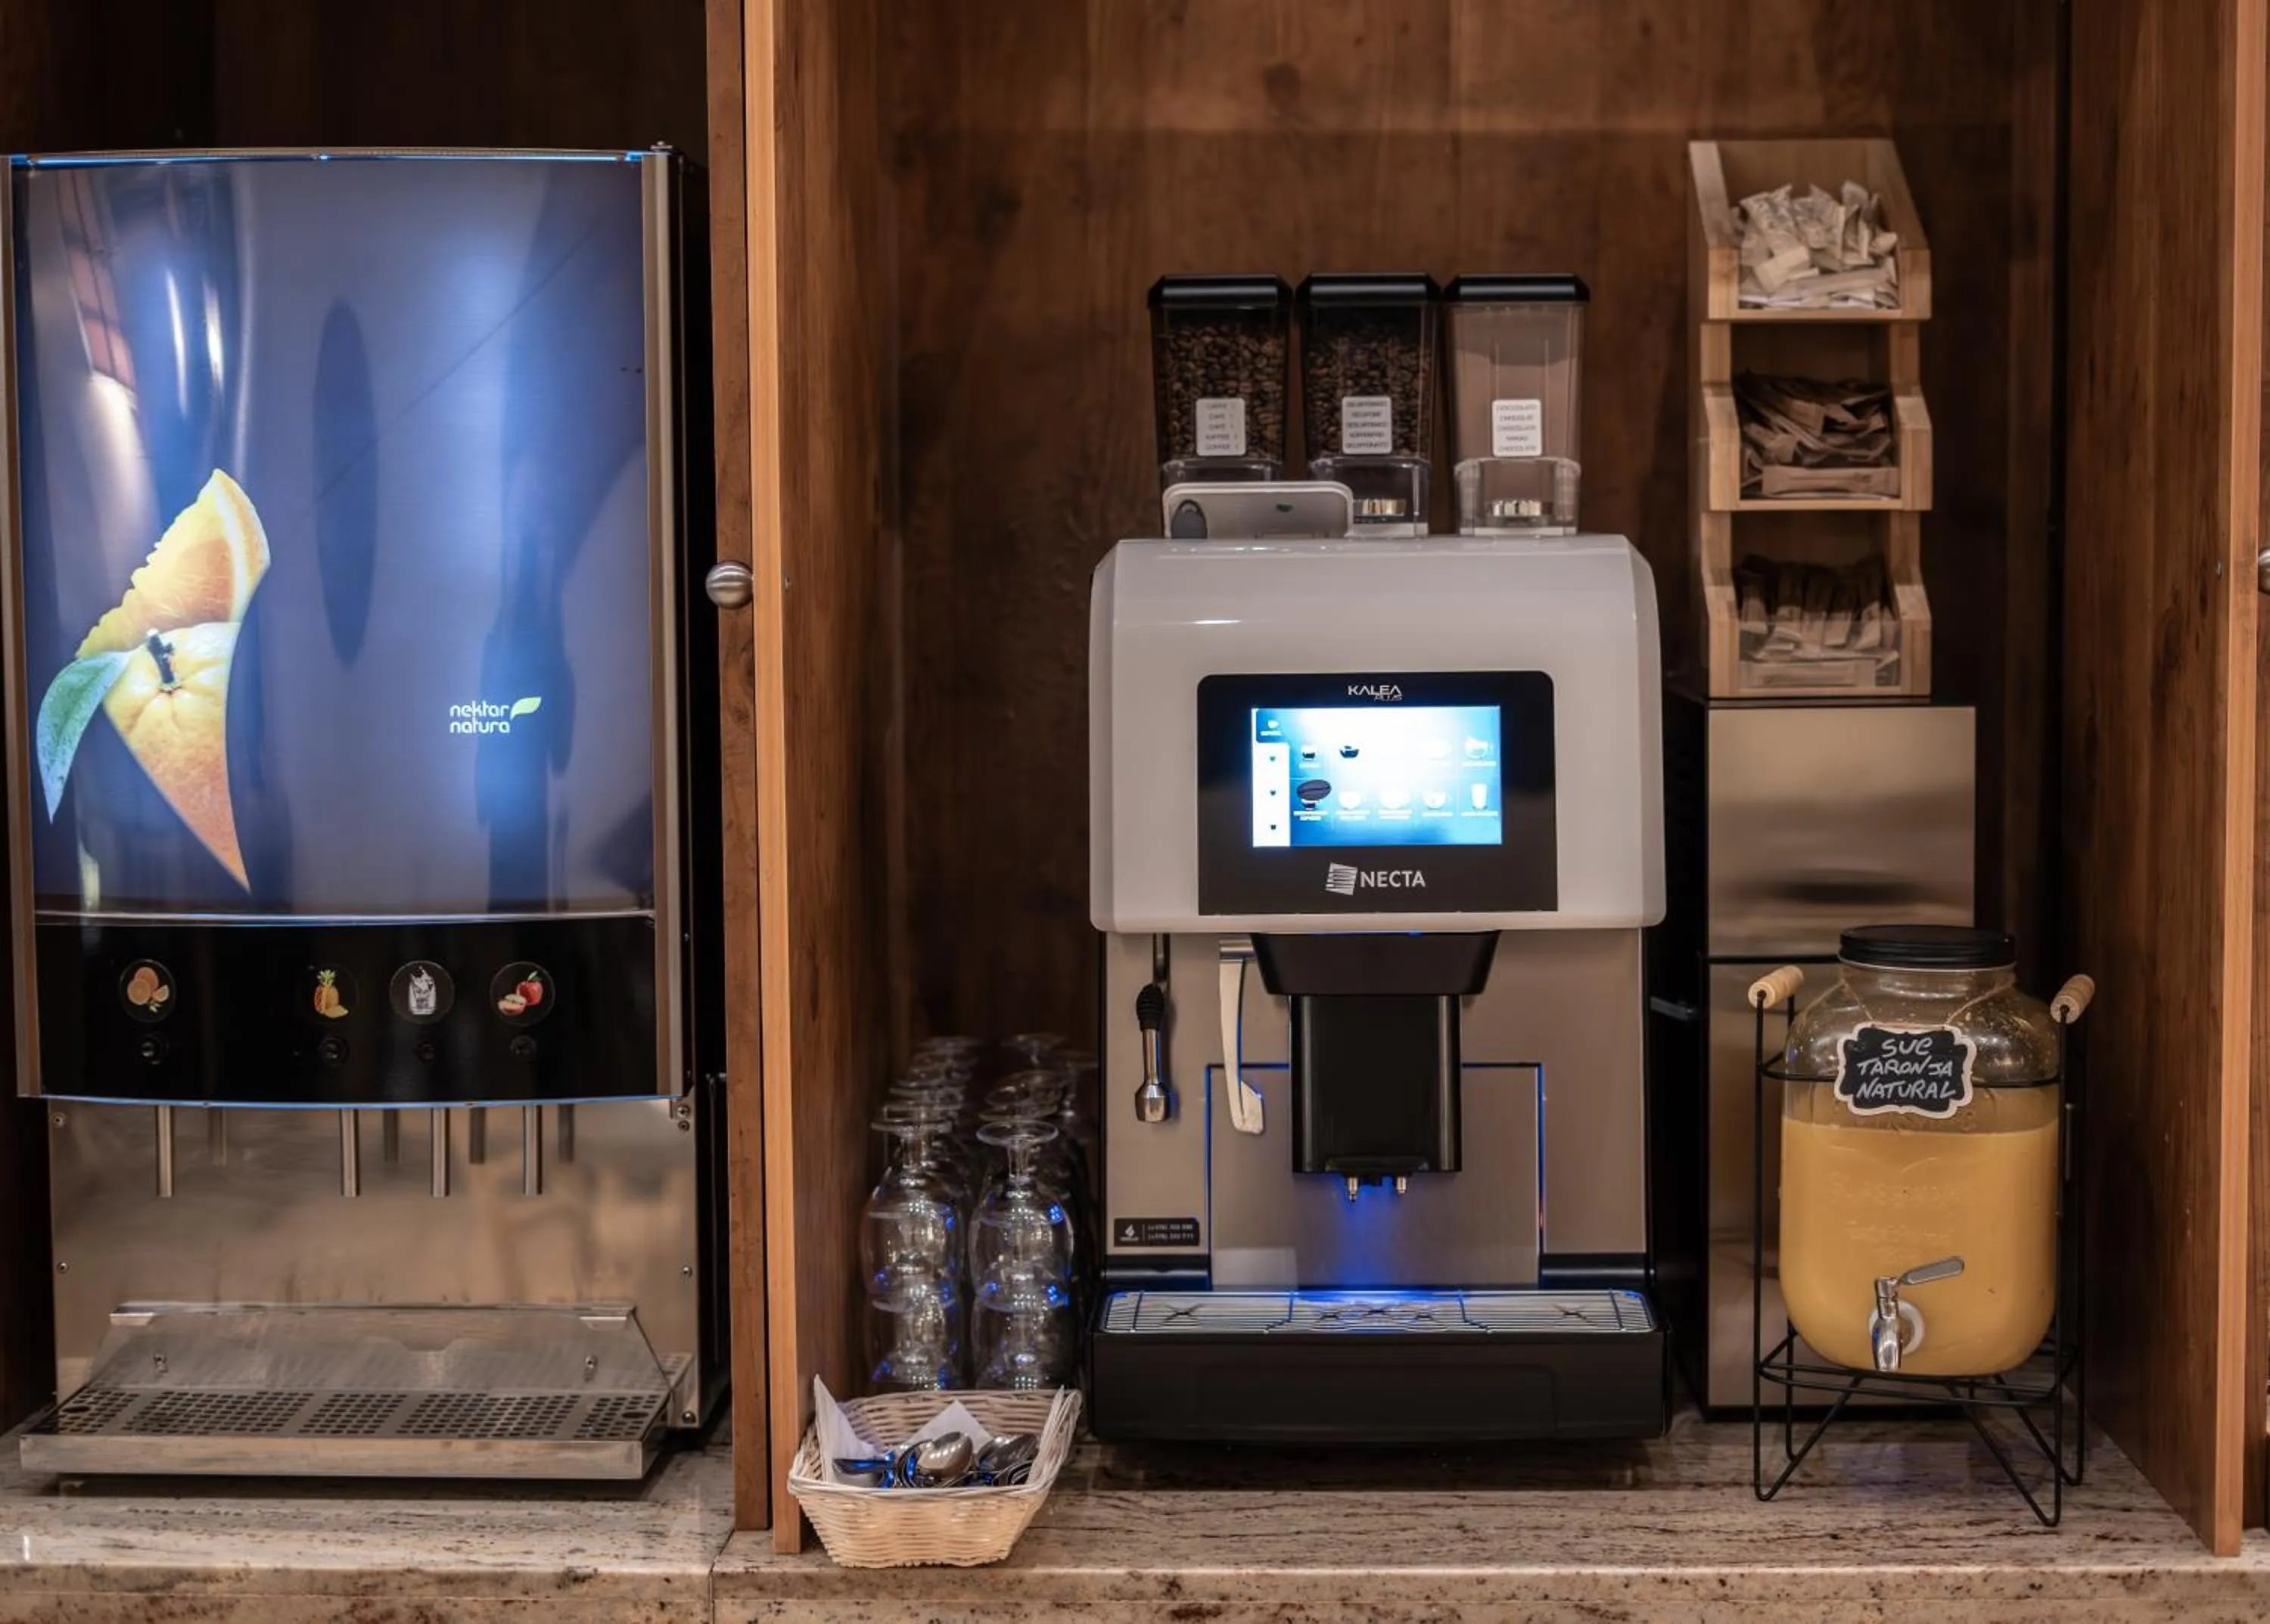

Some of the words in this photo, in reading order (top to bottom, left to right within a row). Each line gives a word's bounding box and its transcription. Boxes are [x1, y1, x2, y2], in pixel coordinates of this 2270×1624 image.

[1348, 685, 1402, 695] KALEA
[449, 700, 510, 717] nektar
[449, 717, 510, 733] natura
[1360, 870, 1426, 888] NECTA
[1856, 1056, 1953, 1077] TARONJA
[1856, 1077, 1956, 1098] NATURAL
